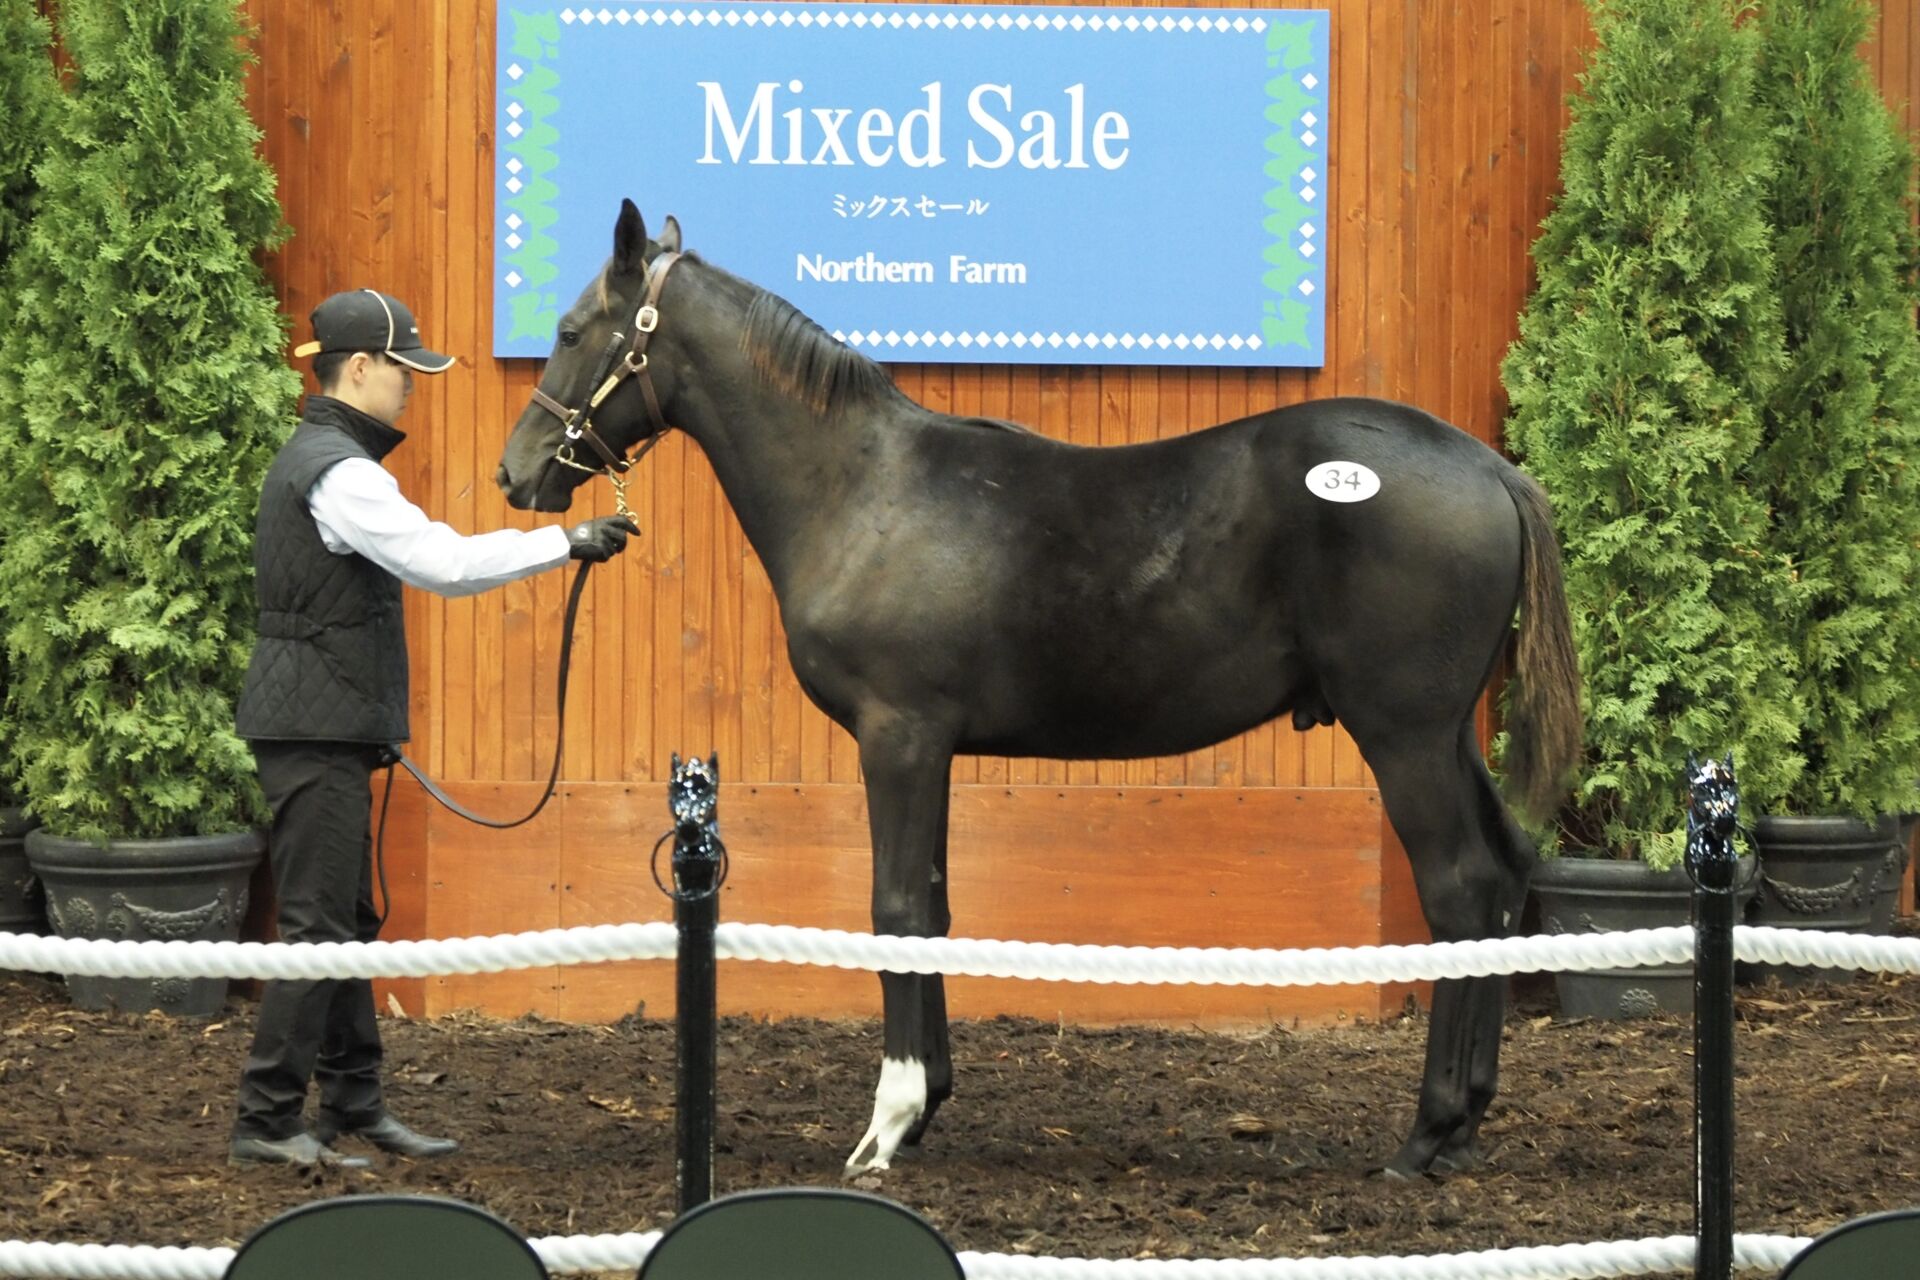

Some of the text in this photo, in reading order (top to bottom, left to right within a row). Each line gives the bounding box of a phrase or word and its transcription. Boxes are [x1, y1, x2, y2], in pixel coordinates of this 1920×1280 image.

[696, 80, 1130, 170] Mixed Sale
[833, 193, 990, 219] ミックスセール
[796, 252, 1027, 284] Northern Farm
[1324, 469, 1361, 491] 34
